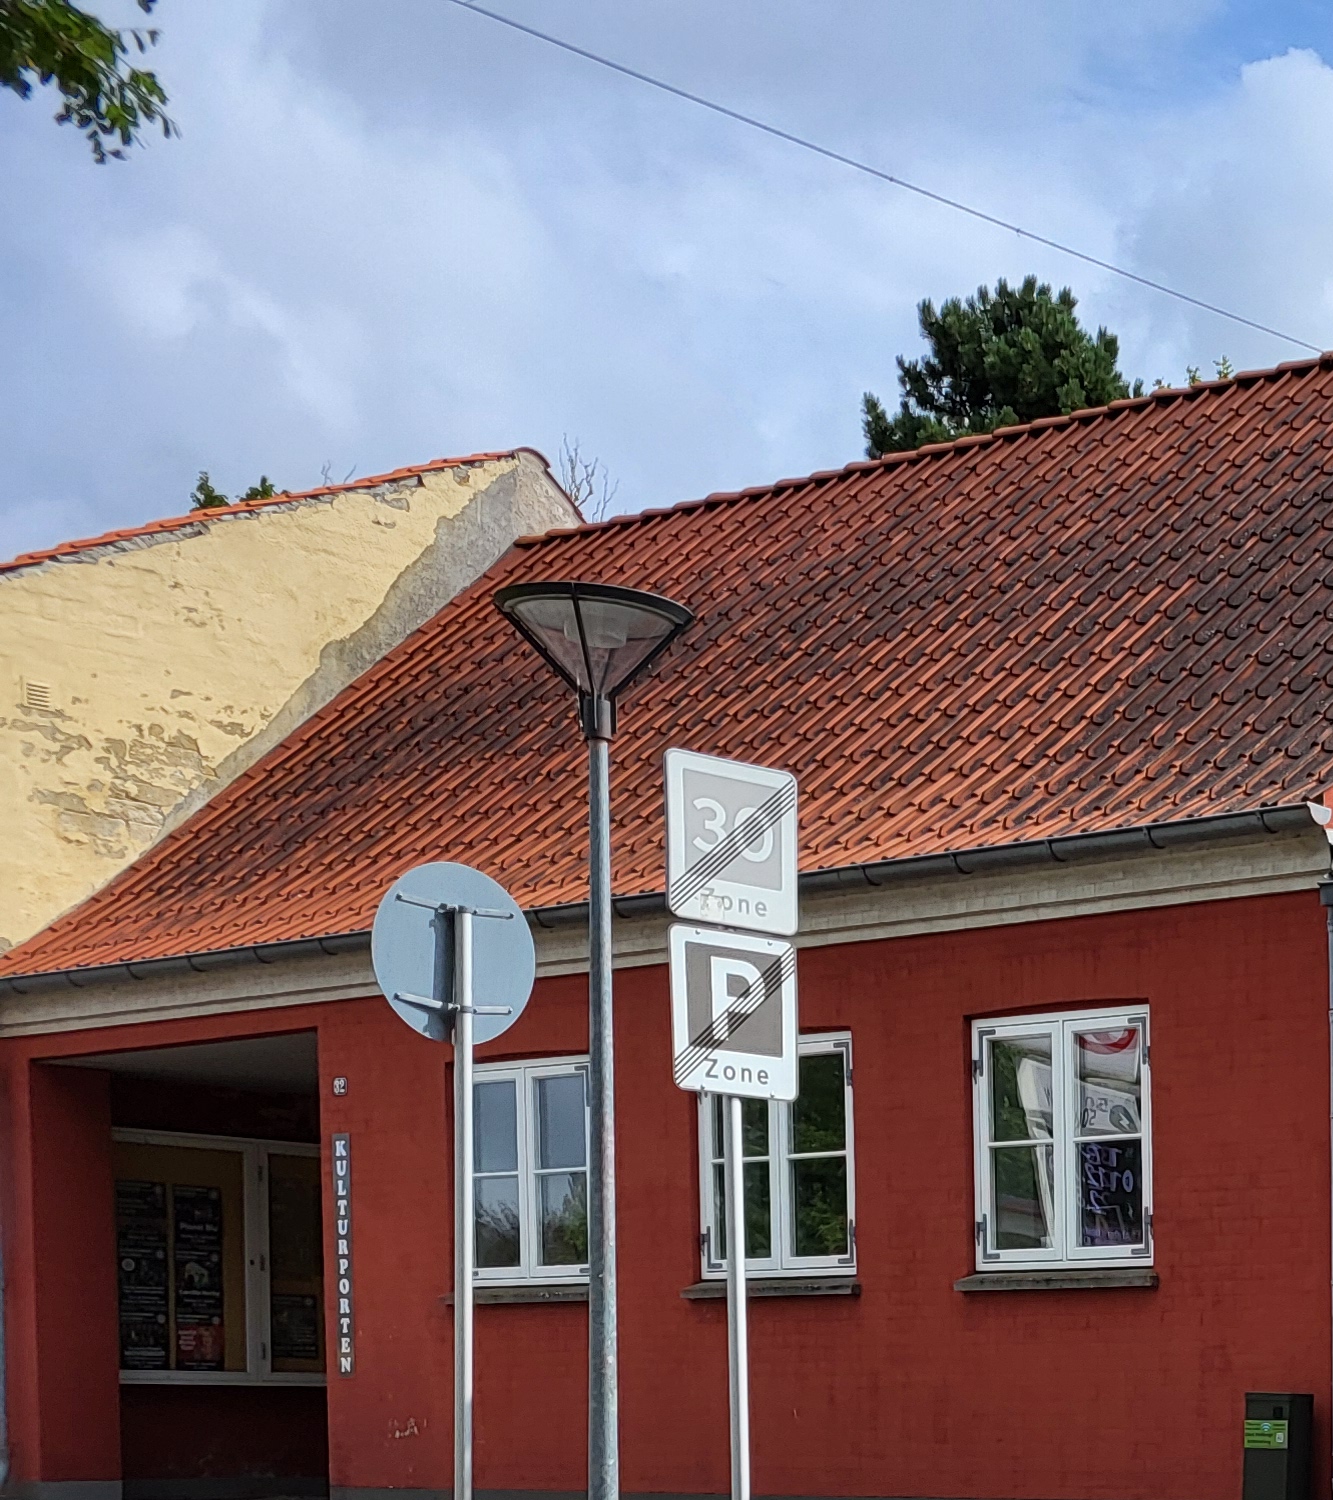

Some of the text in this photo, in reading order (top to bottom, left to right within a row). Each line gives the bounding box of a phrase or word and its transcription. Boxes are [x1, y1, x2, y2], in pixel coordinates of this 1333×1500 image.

[692, 798, 774, 863] 30
[710, 955, 767, 1040] P
[704, 1058, 769, 1085] Zone
[335, 1140, 351, 1374] KULTURPORTEN
